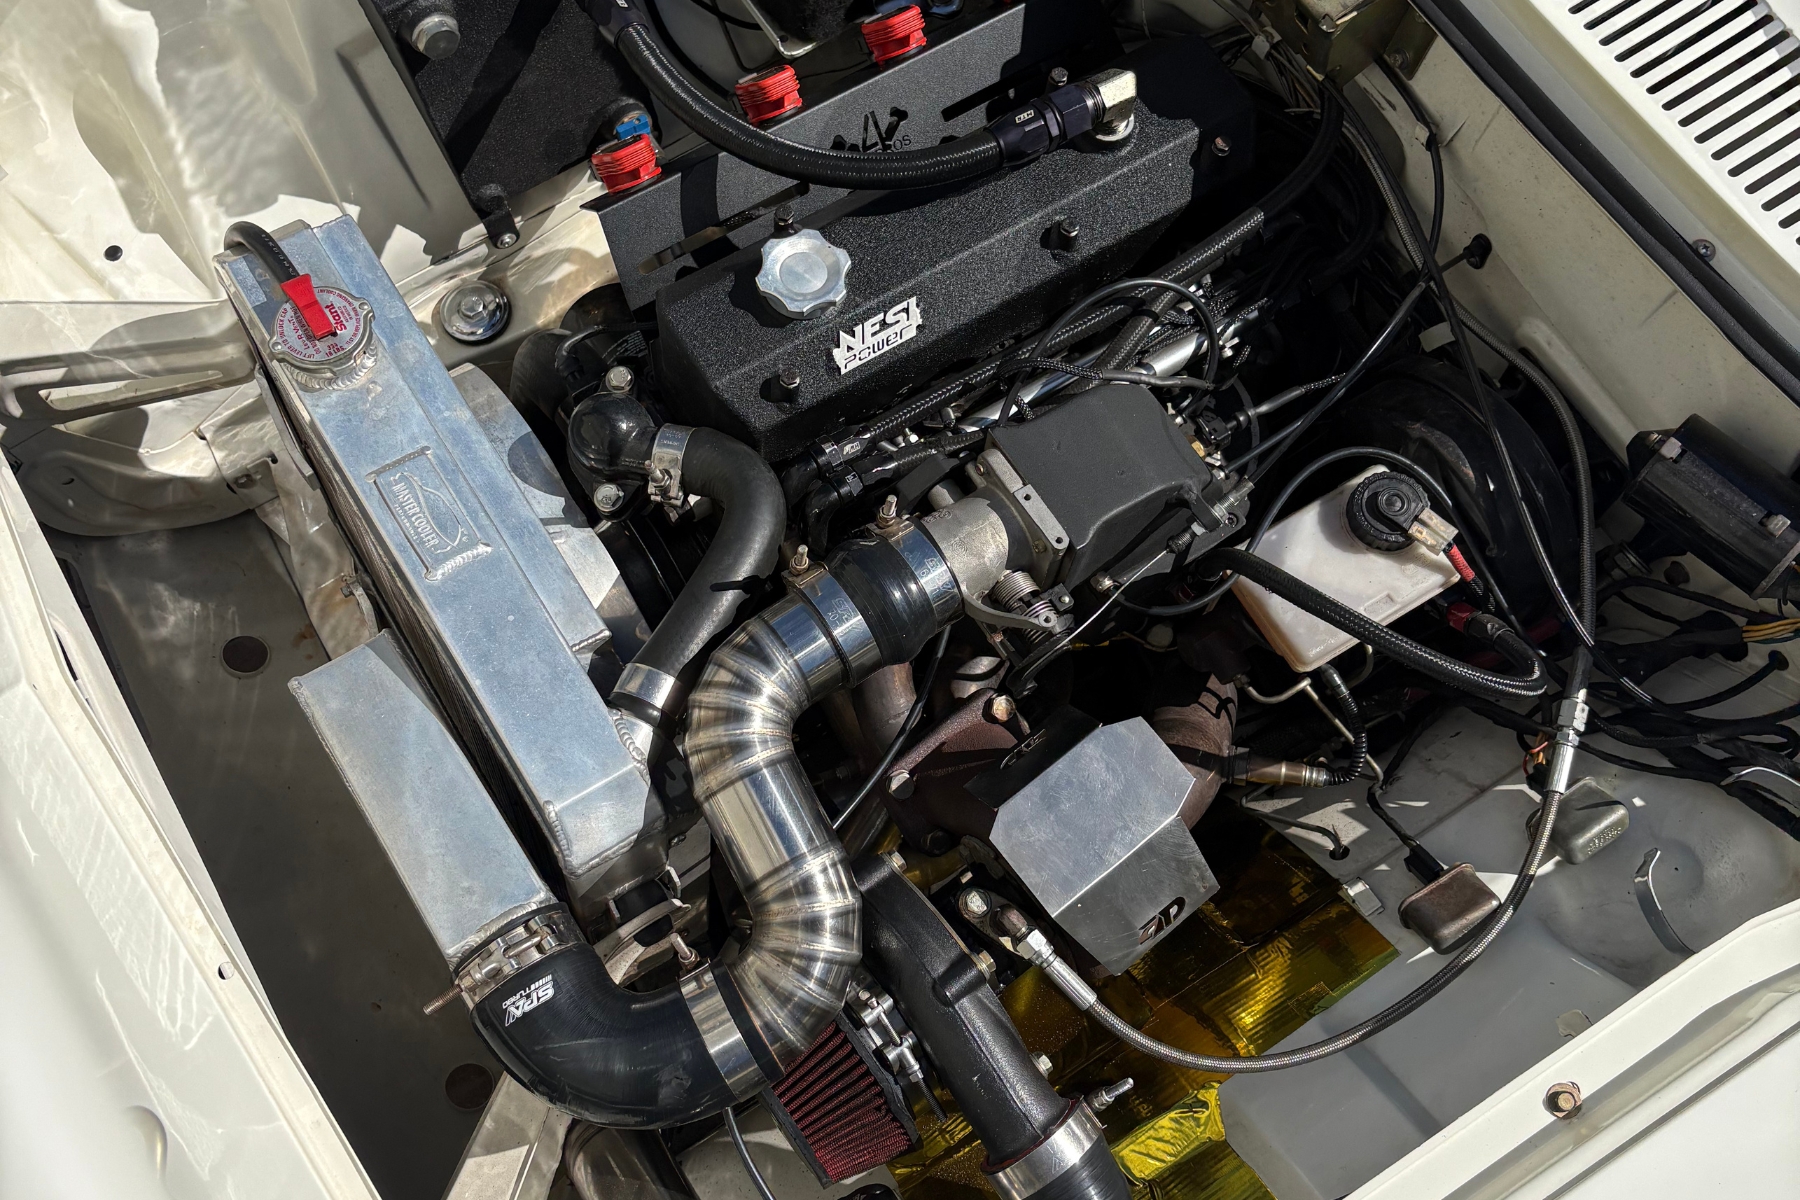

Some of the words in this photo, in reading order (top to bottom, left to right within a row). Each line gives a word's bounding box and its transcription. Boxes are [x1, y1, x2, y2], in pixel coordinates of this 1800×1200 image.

[325, 302, 348, 332] Stant
[281, 338, 290, 347] TO
[287, 344, 303, 356] LEVER
[392, 482, 421, 516] MASTER
[411, 513, 440, 549] COOLER
[502, 987, 530, 1009] TURBO
[506, 981, 555, 1020] SPA
